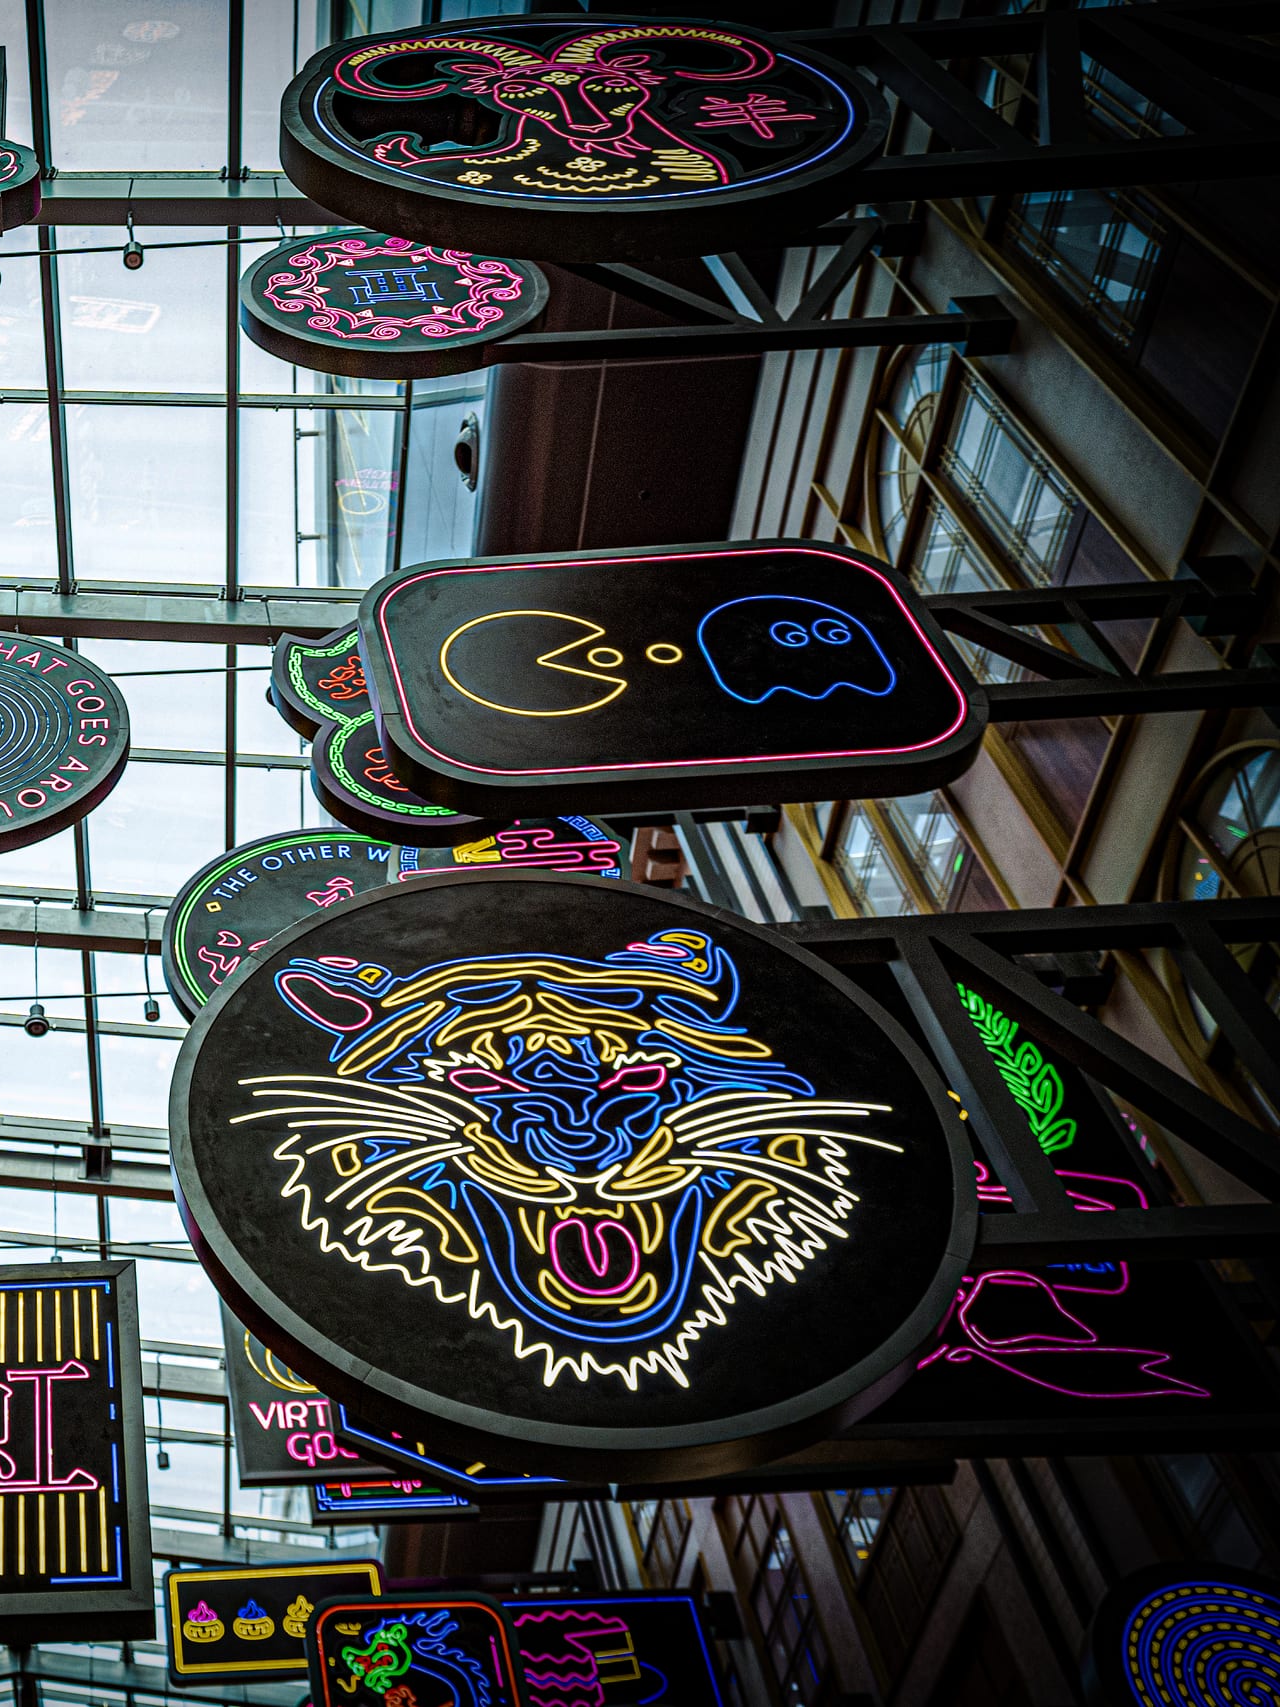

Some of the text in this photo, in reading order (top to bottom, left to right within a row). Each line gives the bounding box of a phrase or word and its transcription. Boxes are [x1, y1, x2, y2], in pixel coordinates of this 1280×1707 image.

[692, 92, 818, 140] 羊
[65, 678, 111, 748] GOES
[212, 867, 260, 901] THE
[260, 844, 353, 871] OTHER
